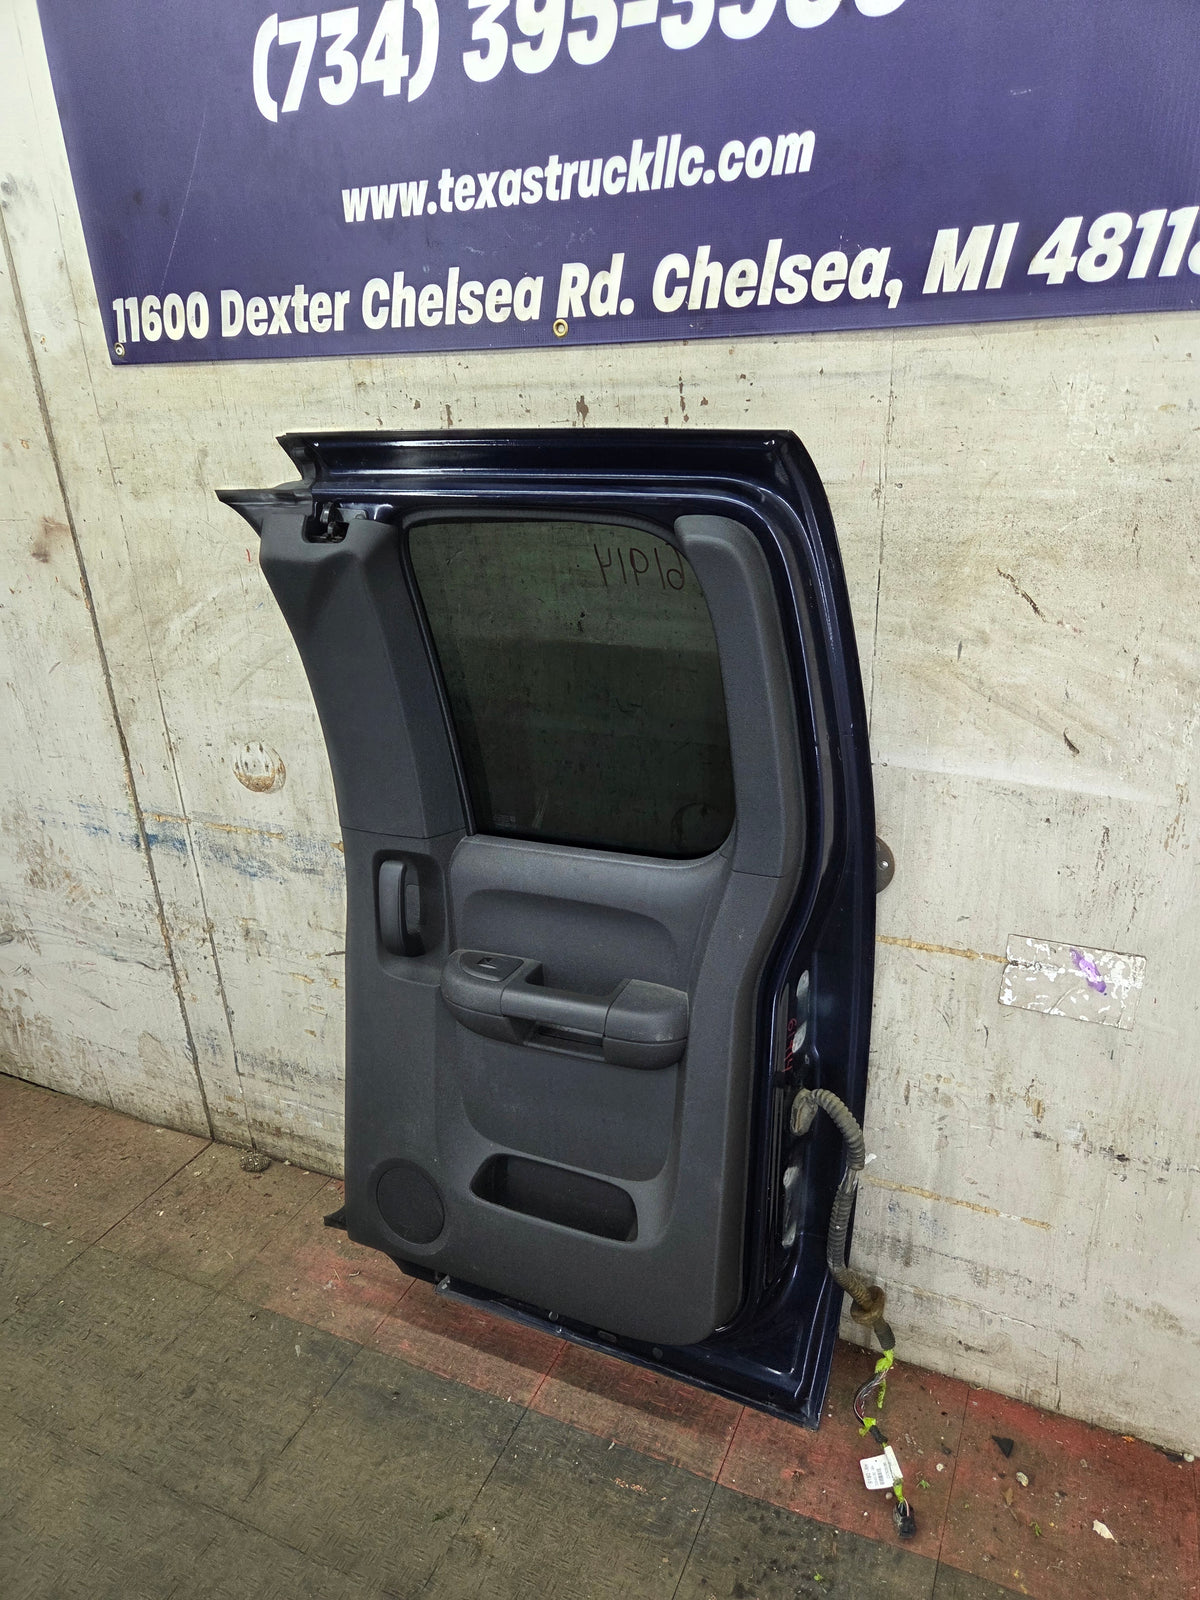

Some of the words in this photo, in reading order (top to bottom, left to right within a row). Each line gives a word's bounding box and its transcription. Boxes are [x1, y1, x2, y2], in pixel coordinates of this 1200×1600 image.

[252, 0, 440, 124] (734)
[341, 130, 816, 223] www.texastruckllc.com
[112, 291, 210, 344] 11600
[220, 284, 351, 338] Dexter
[361, 266, 544, 330] Chelsea
[555, 252, 635, 319] Rd.
[652, 238, 903, 313] Chelsea,
[922, 221, 1020, 295] MI
[1027, 205, 1200, 285] 4811
